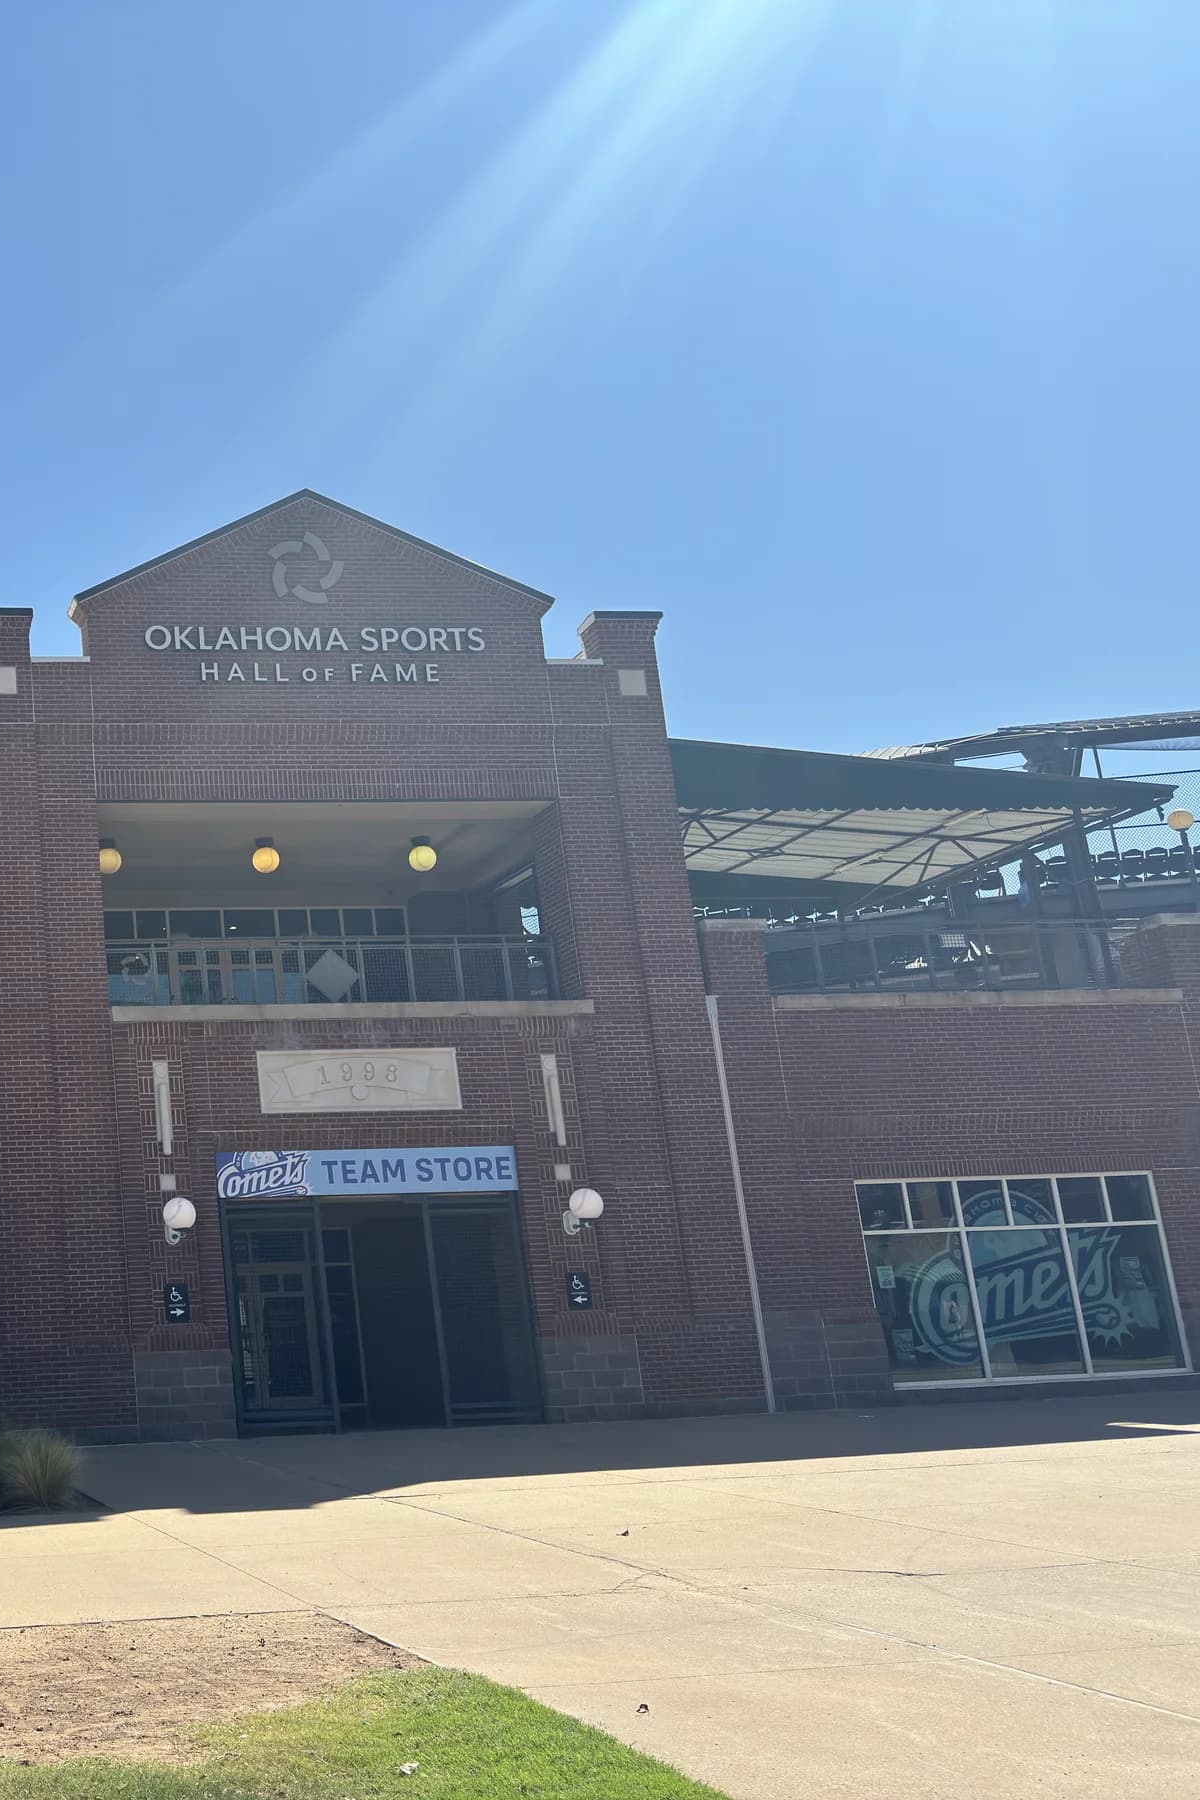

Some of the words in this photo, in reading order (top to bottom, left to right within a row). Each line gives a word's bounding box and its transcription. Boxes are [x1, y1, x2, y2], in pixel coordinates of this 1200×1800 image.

[144, 625, 349, 651] OKLAHOMA
[360, 626, 486, 652] SPORTS
[200, 662, 290, 682] HALL
[351, 663, 441, 683] FAME
[316, 1061, 399, 1085] 1998
[217, 1154, 307, 1198] Comets
[320, 1158, 407, 1185] TEAM
[415, 1156, 513, 1182] STORE
[912, 1228, 1118, 1364] Comets
